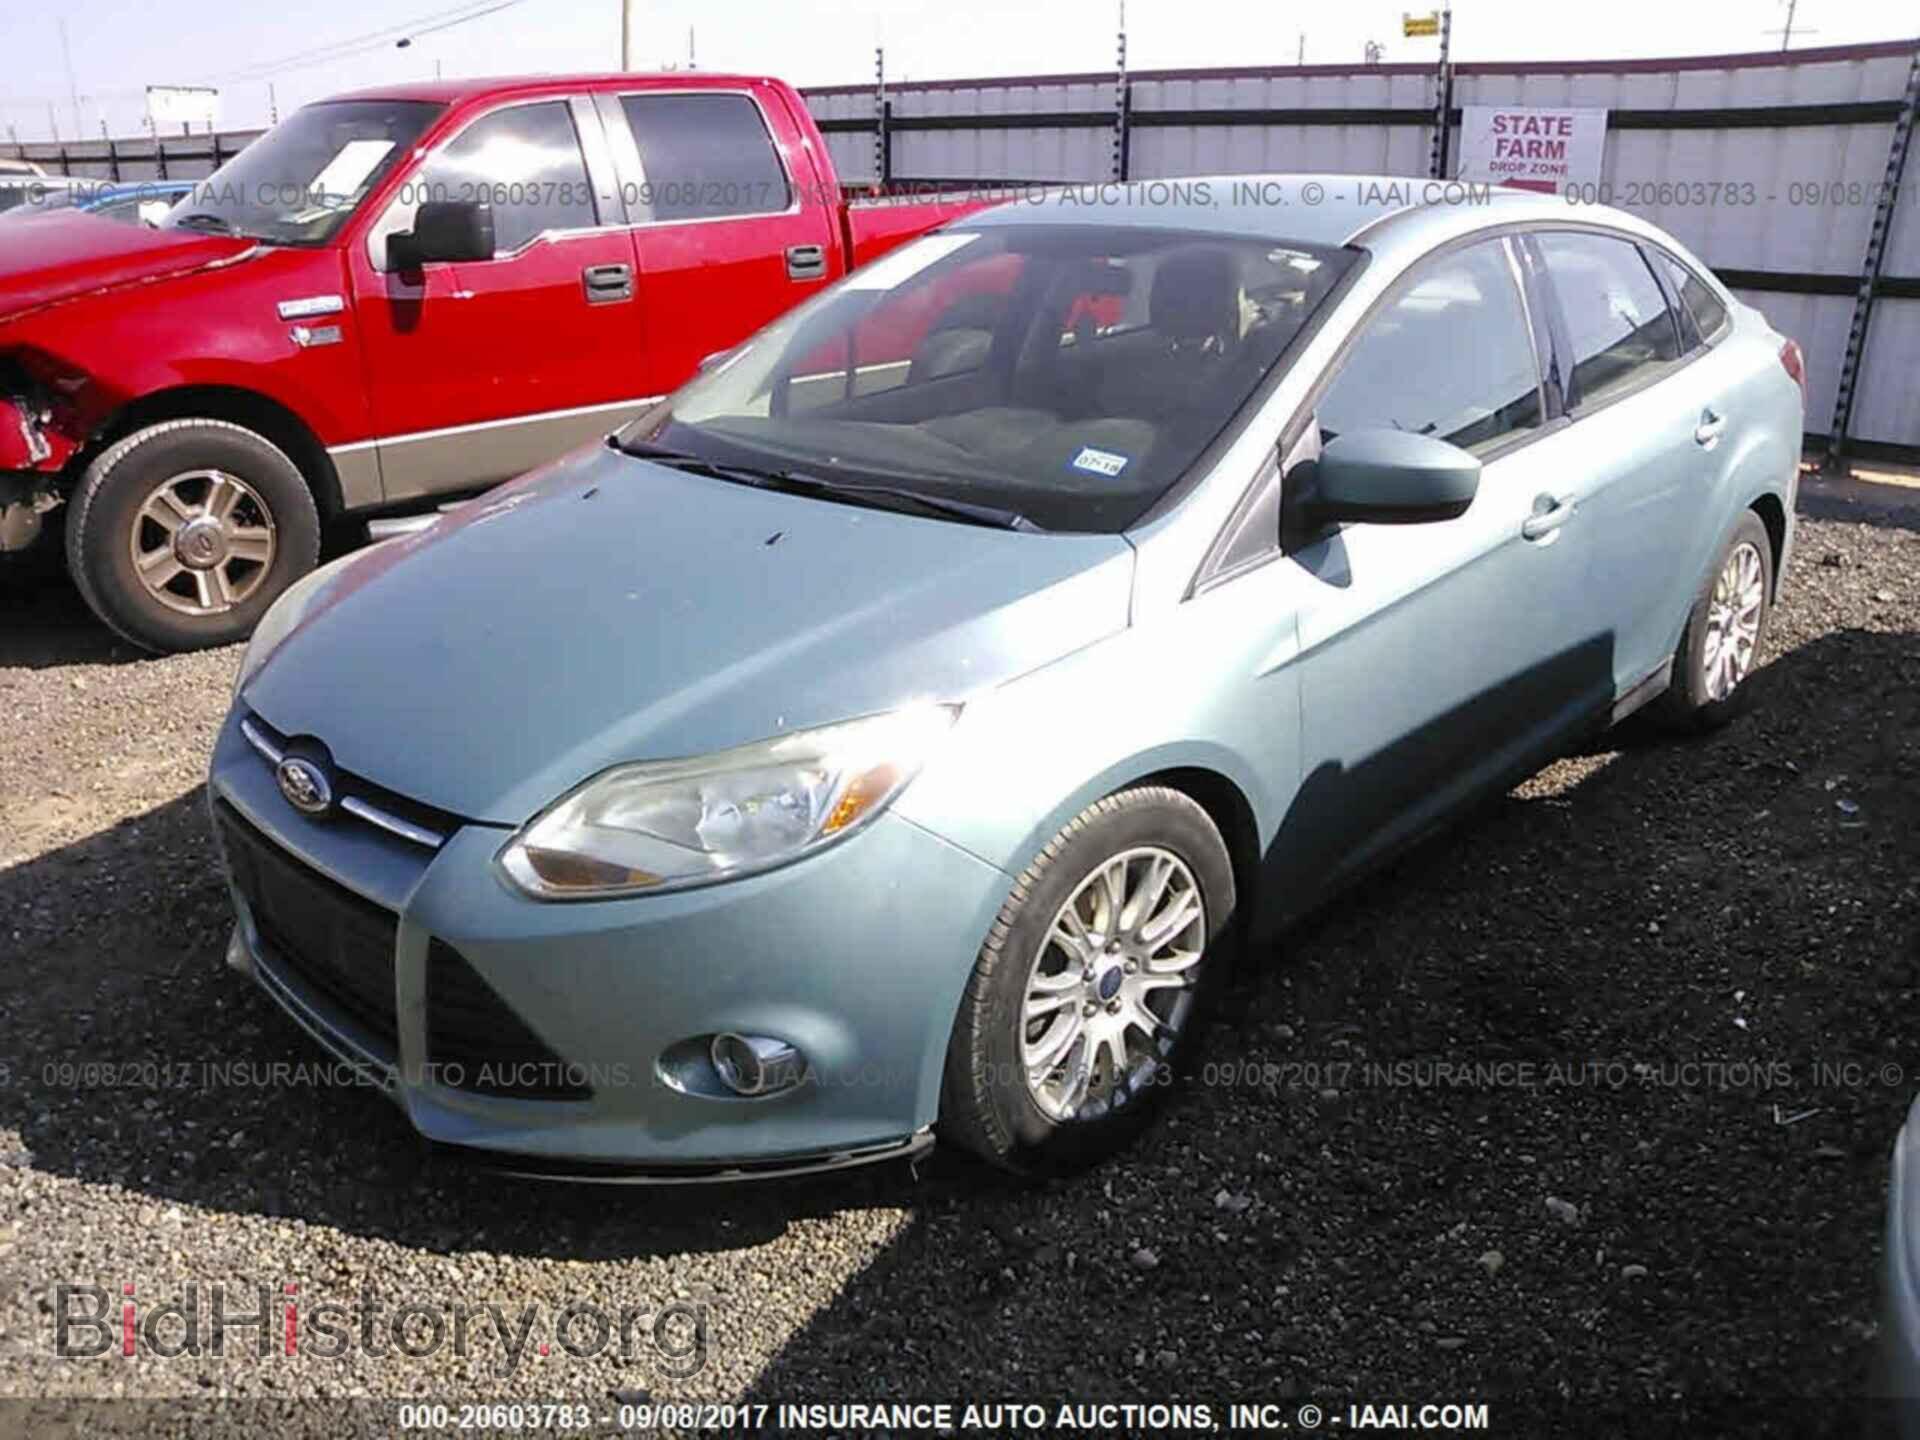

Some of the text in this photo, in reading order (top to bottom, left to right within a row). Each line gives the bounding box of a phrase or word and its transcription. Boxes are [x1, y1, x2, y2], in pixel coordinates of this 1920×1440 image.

[1493, 114, 1573, 137] STATE
[1495, 138, 1566, 159] FARM
[1489, 161, 1568, 175] DROP ZONE
